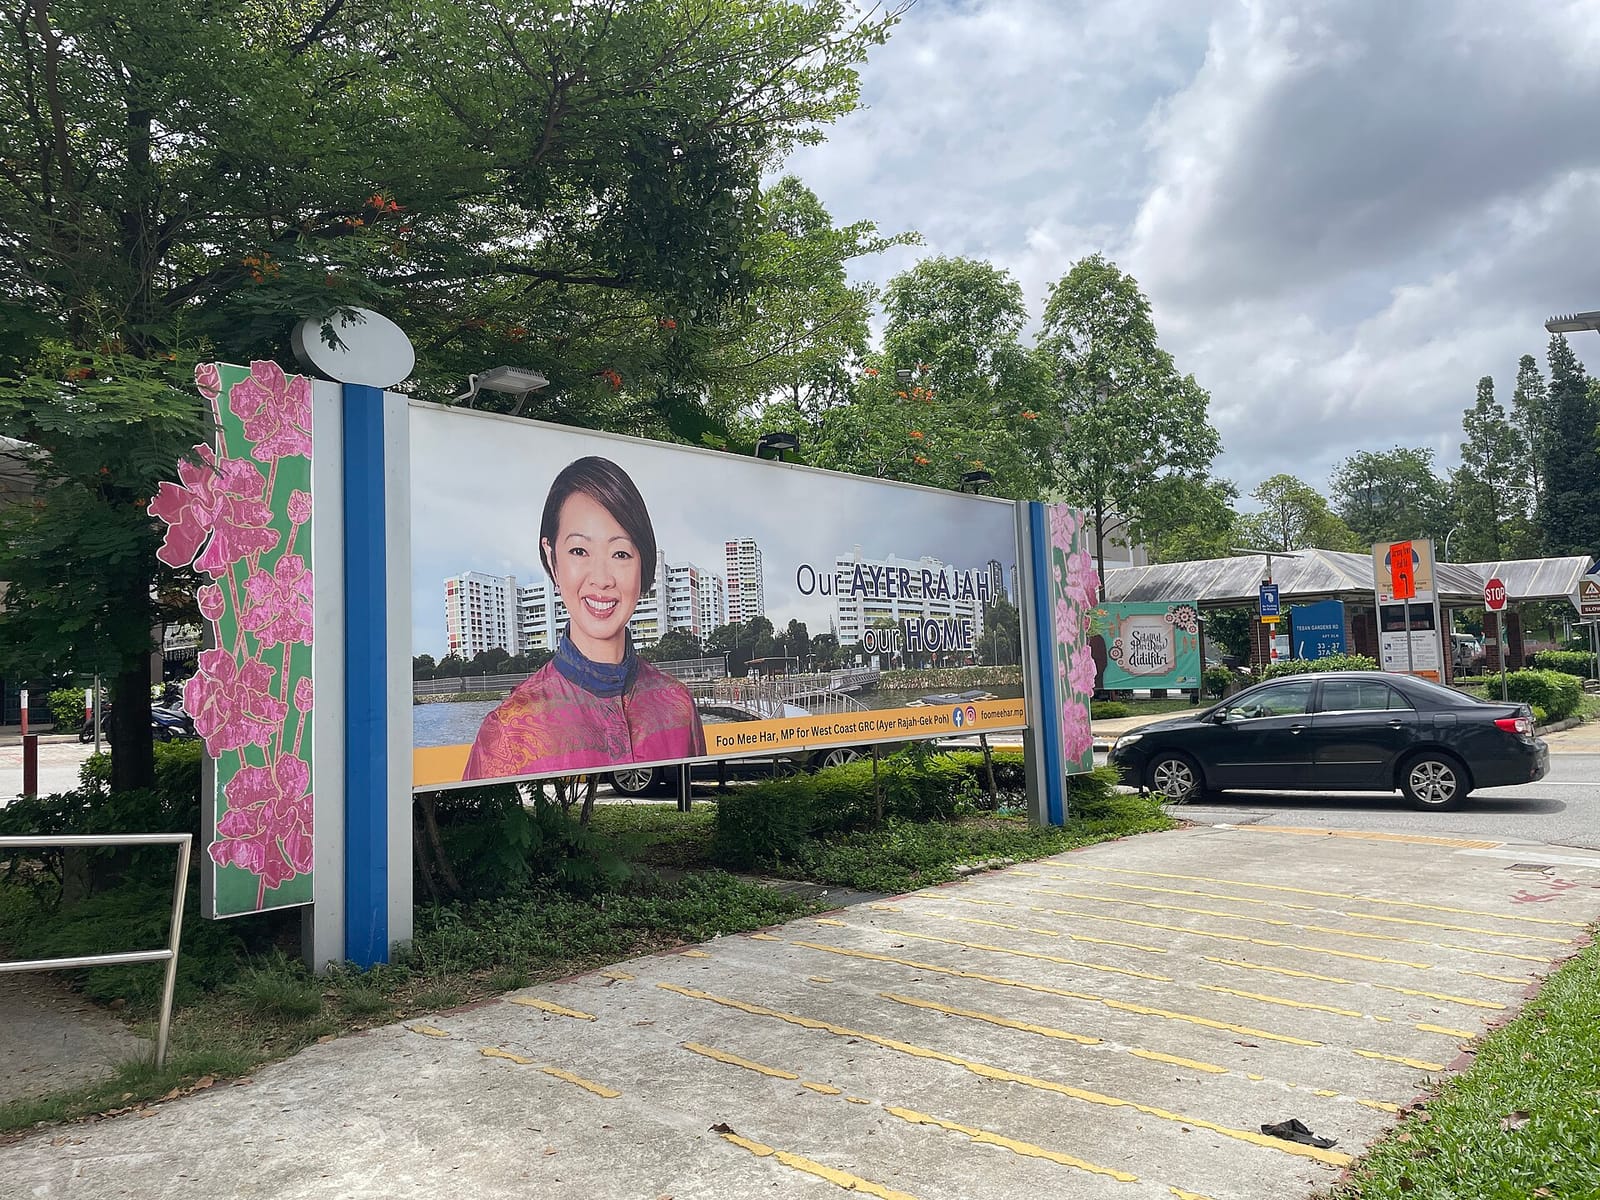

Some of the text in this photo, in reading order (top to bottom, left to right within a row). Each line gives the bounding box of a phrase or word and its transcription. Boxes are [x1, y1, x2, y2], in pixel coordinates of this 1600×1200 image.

[796, 563, 997, 608] Our AYER RAJAH,
[1485, 587, 1505, 602] STOP
[863, 619, 973, 653] our HOME
[1331, 642, 1340, 650] 37
[981, 708, 1023, 721] foomeehar.mp
[716, 714, 950, 747] Foo Mee Har, MP for West Coast GRC (Ayer Rajah-Gek Poh)
